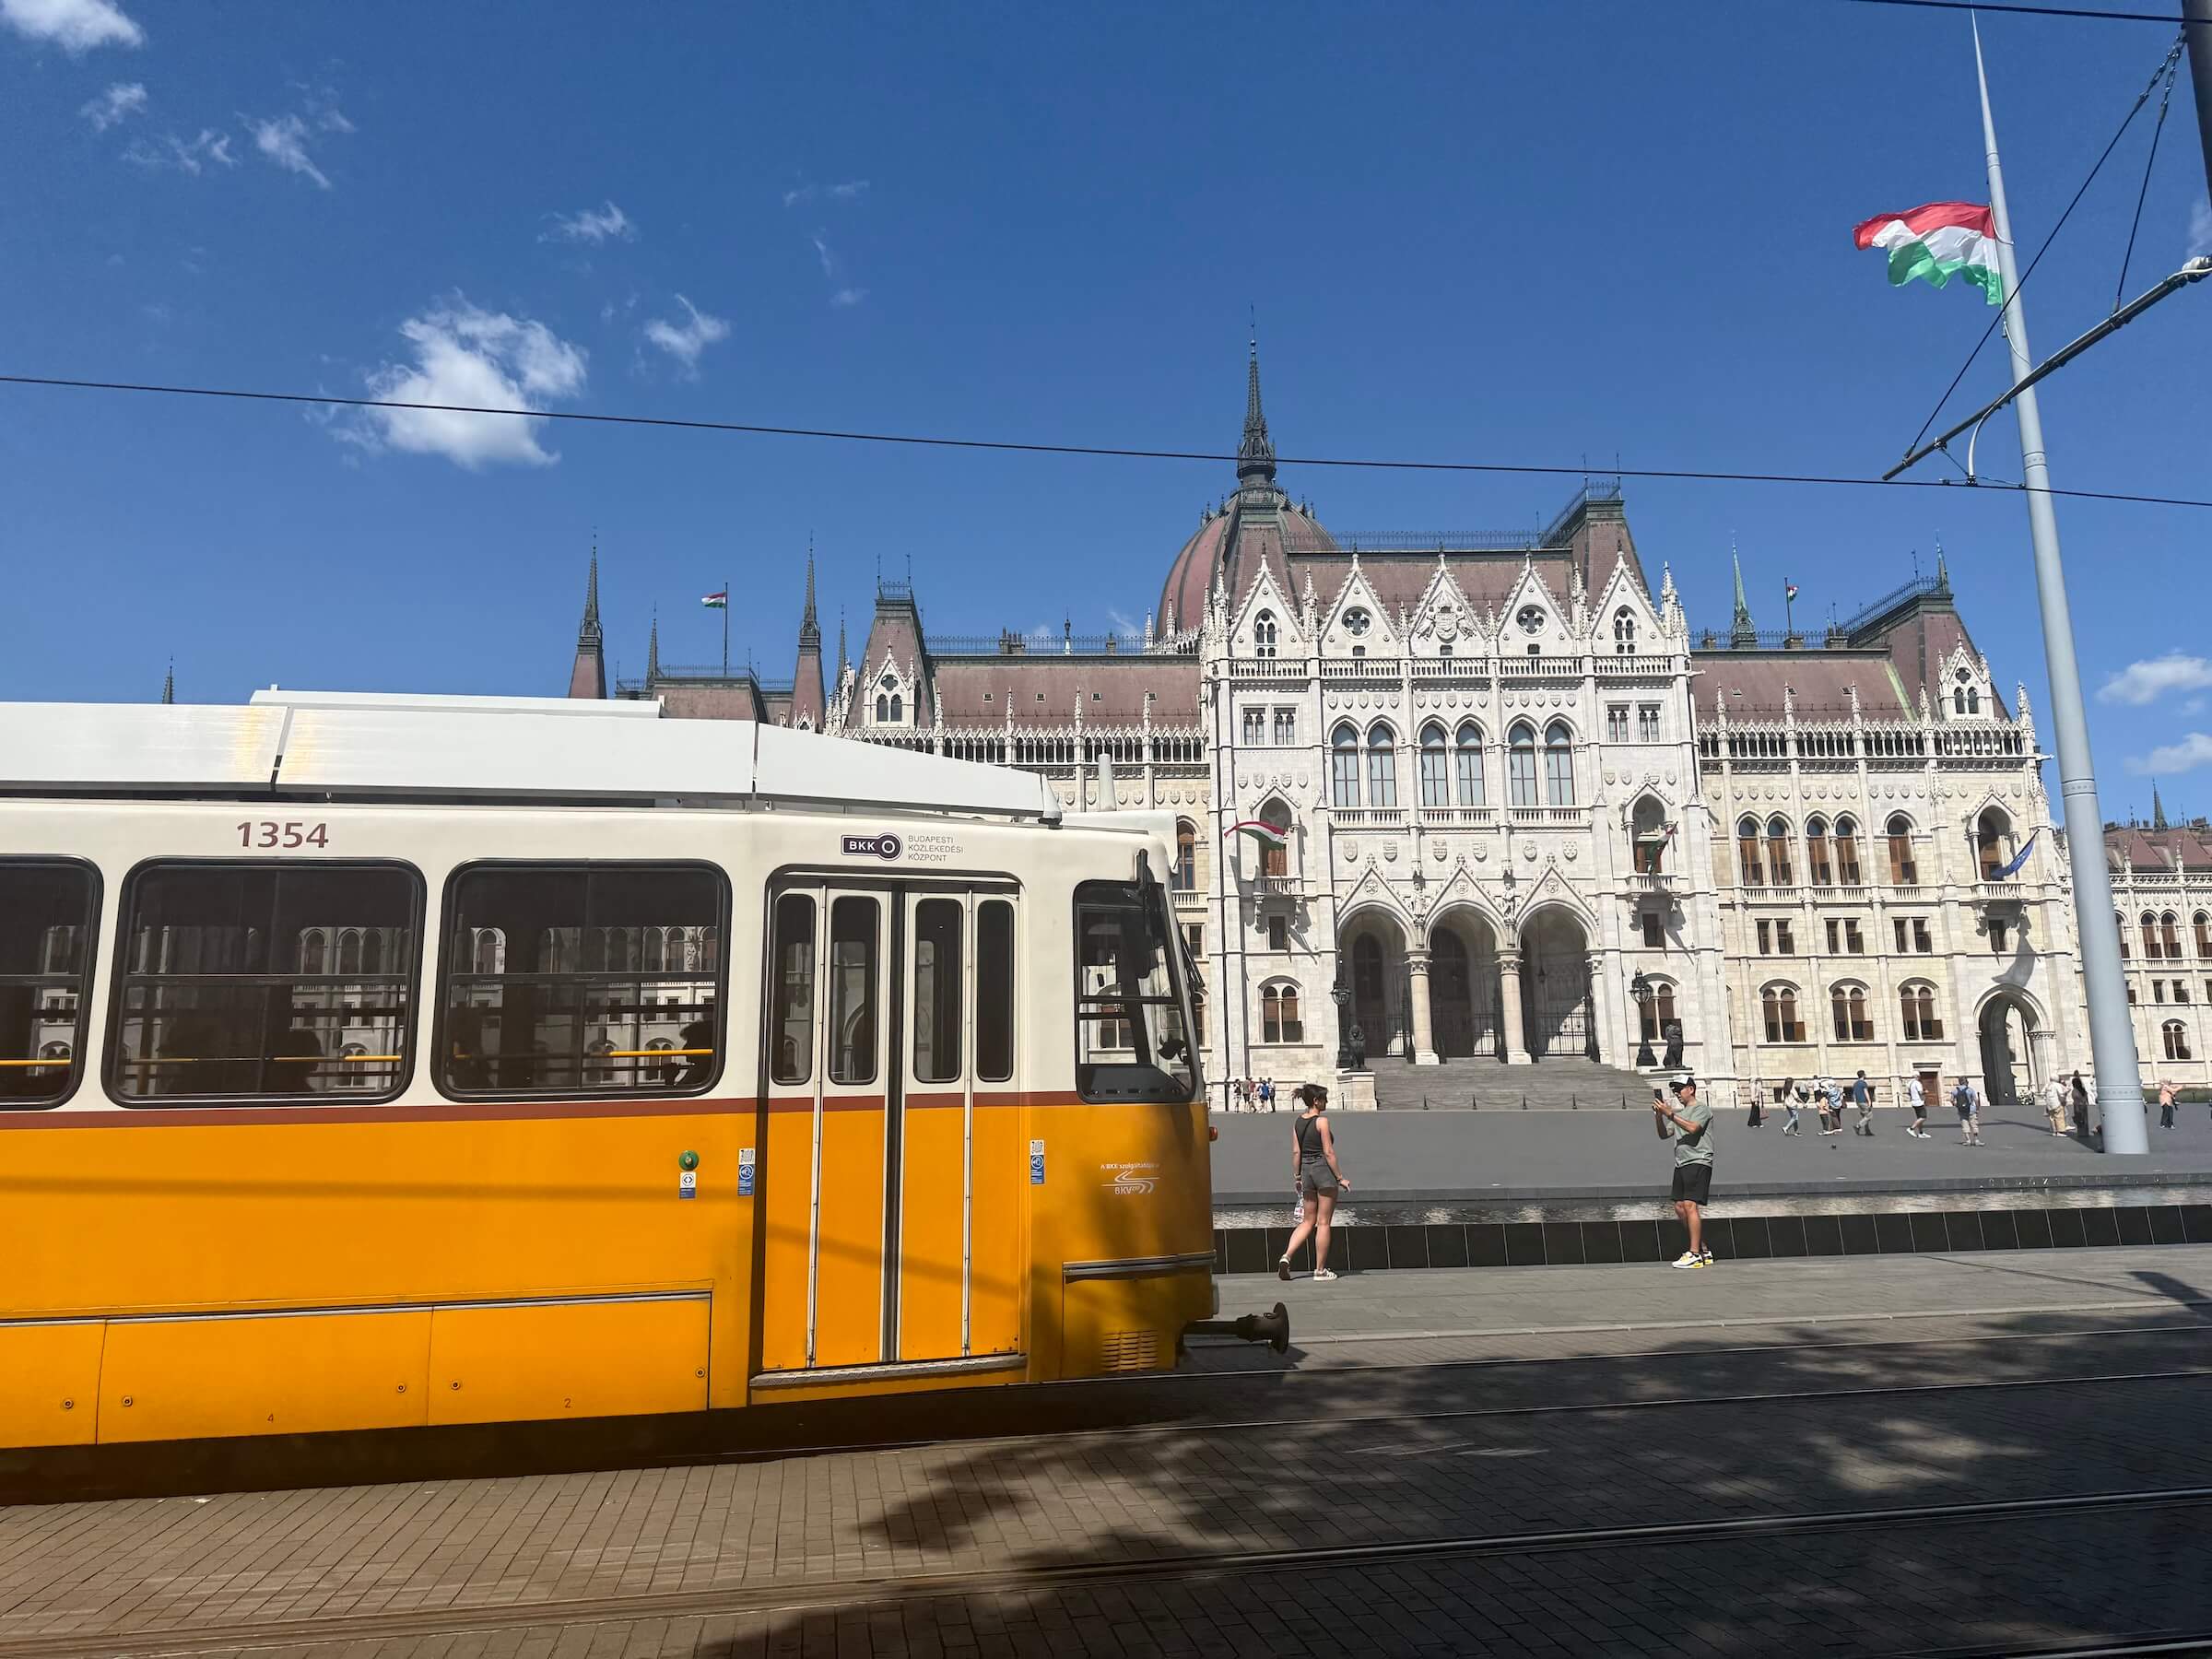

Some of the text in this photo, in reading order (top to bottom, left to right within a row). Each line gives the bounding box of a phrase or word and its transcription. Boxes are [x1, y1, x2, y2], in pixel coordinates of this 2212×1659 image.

[237, 821, 329, 849] 1354
[908, 835, 954, 844] BUDAPESTI
[849, 841, 876, 851] BKK
[908, 843, 964, 853] KÖZLEKEDÉSI
[908, 853, 947, 862] KÖZPONT
[564, 1397, 571, 1408] 2
